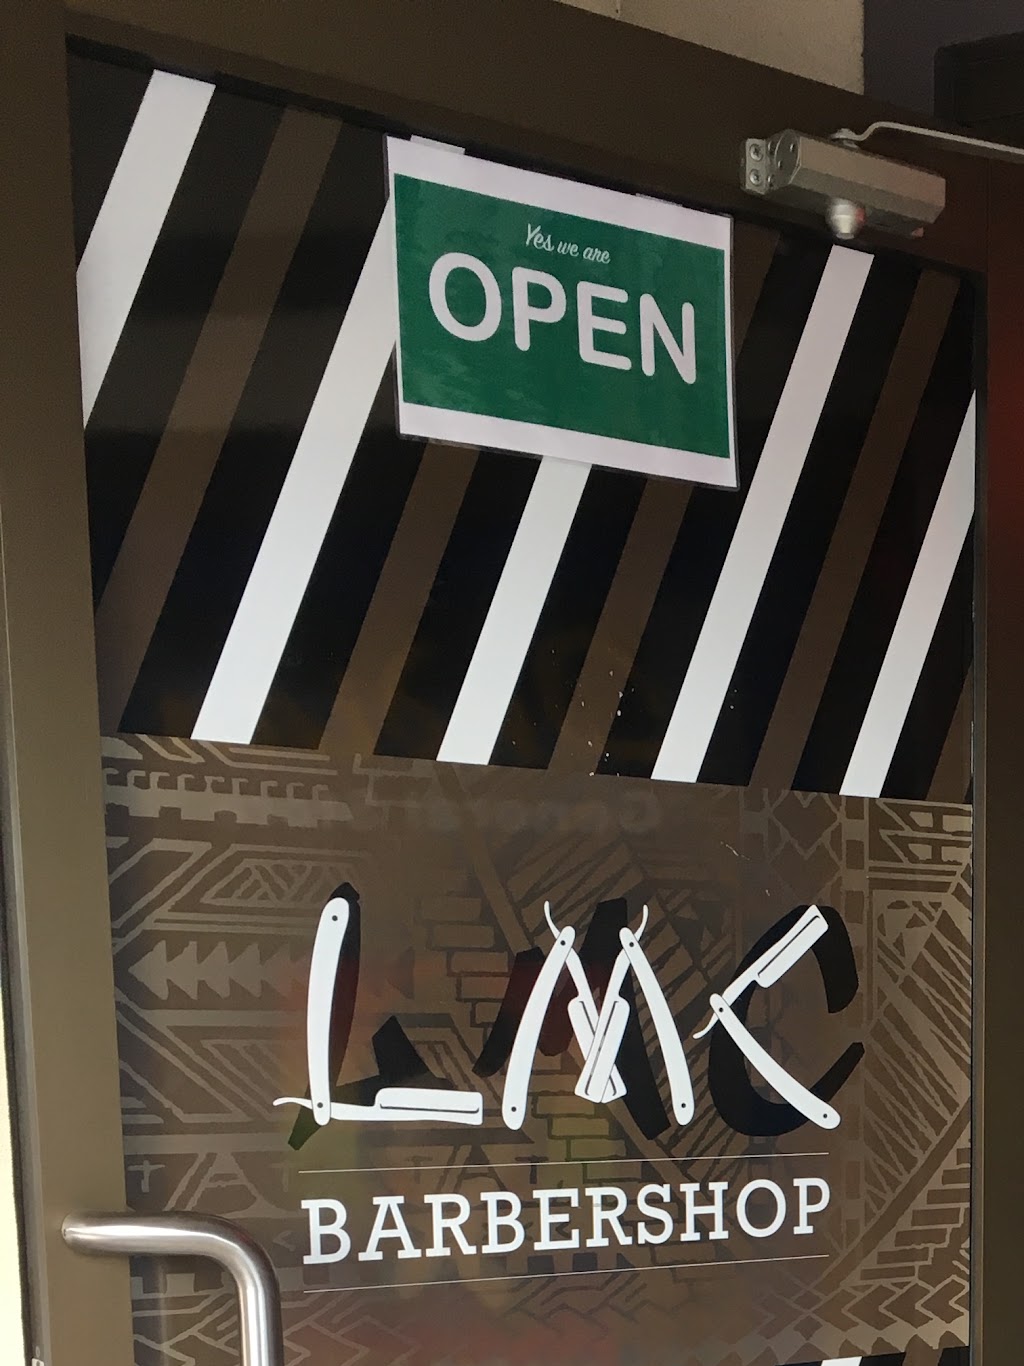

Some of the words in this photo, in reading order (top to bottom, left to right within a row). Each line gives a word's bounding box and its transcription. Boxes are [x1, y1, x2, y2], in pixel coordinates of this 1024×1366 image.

[525, 223, 555, 250] Yes
[557, 241, 579, 257] we
[583, 245, 611, 265] are
[428, 252, 697, 385] OPEN
[273, 896, 846, 1134] LMC
[301, 1177, 831, 1265] BARBERSHOP
